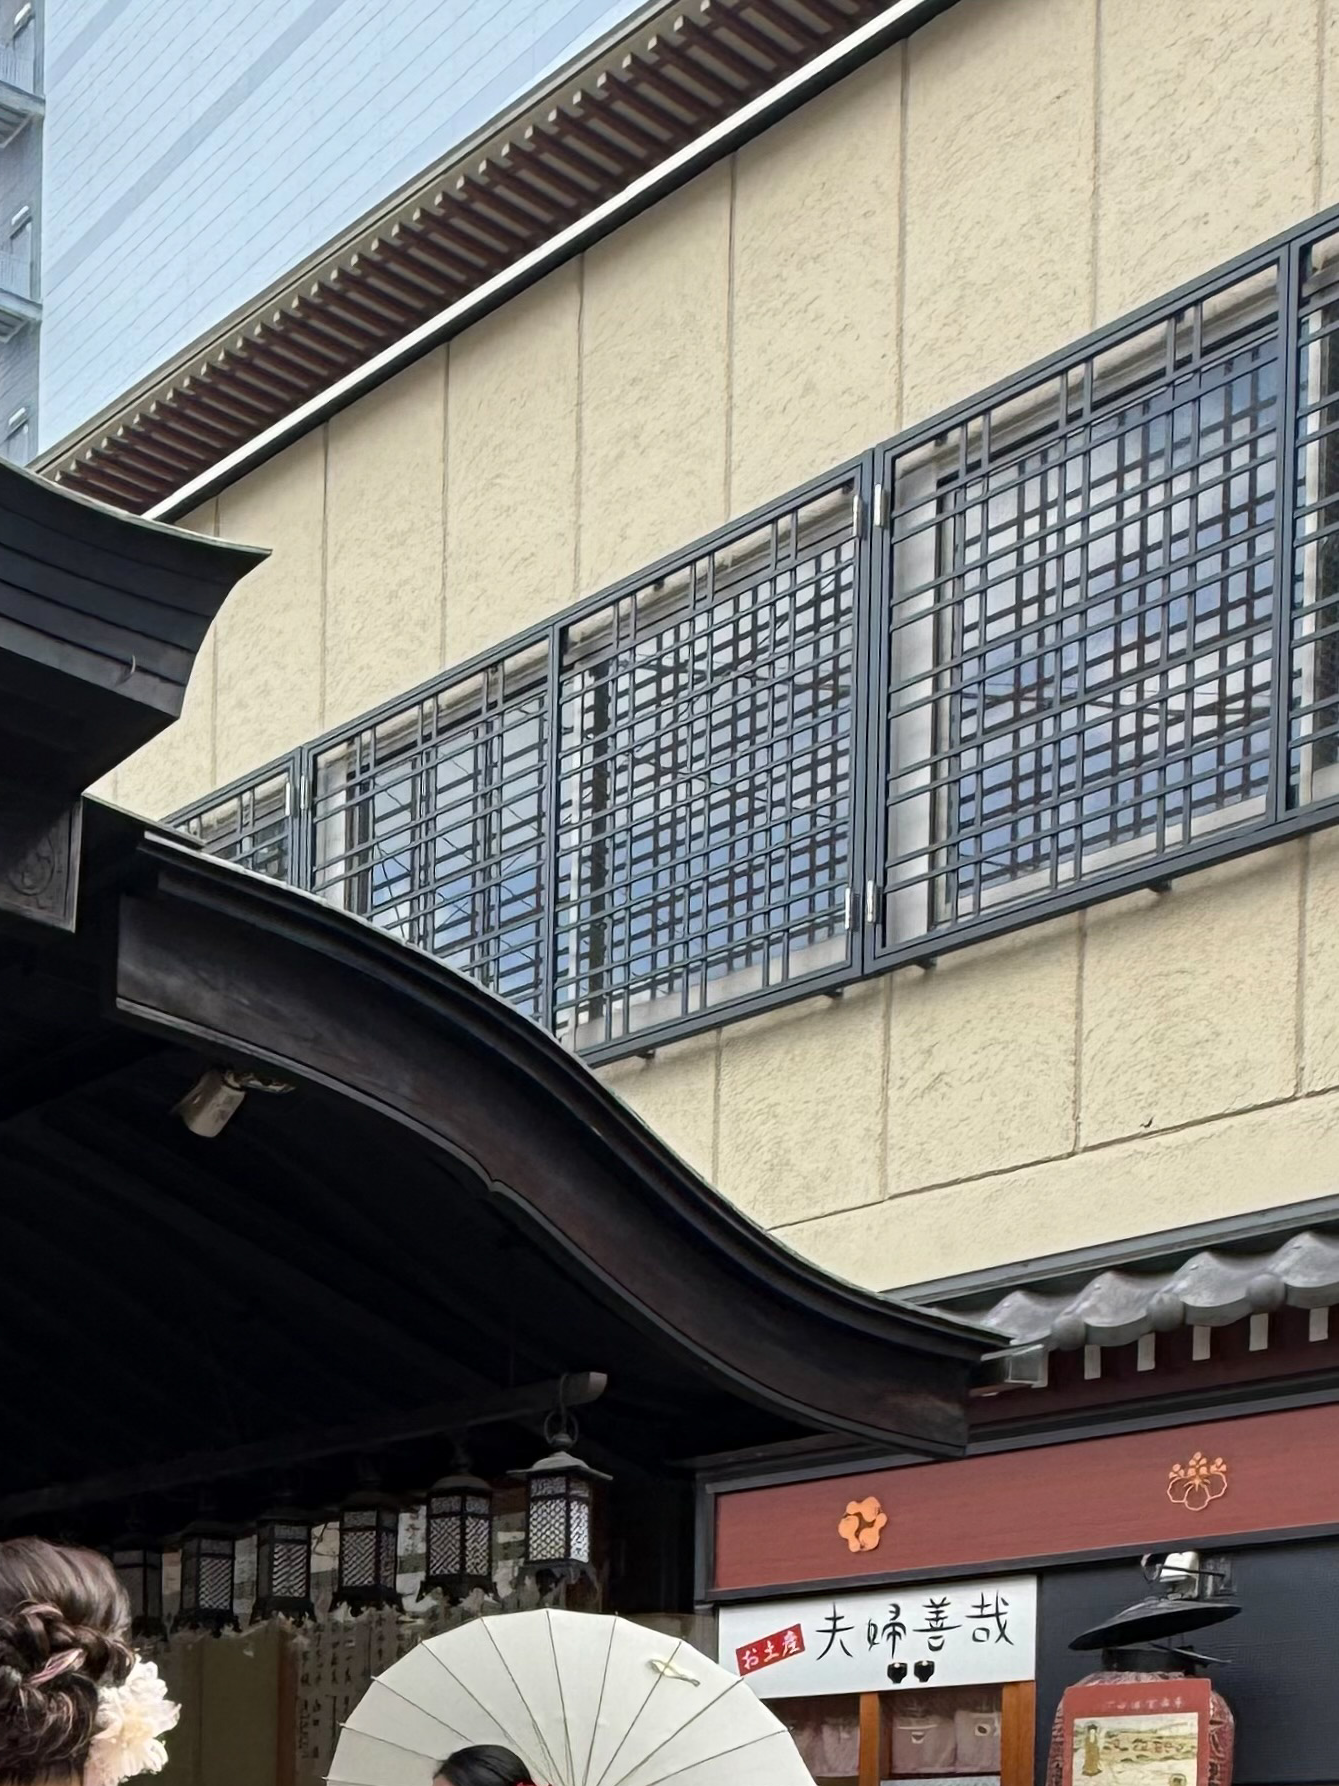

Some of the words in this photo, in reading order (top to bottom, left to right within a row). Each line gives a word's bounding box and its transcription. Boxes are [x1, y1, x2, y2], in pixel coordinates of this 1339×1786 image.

[741, 1630, 802, 1670] お土産
[815, 1589, 1014, 1661] 夫婦善哉
